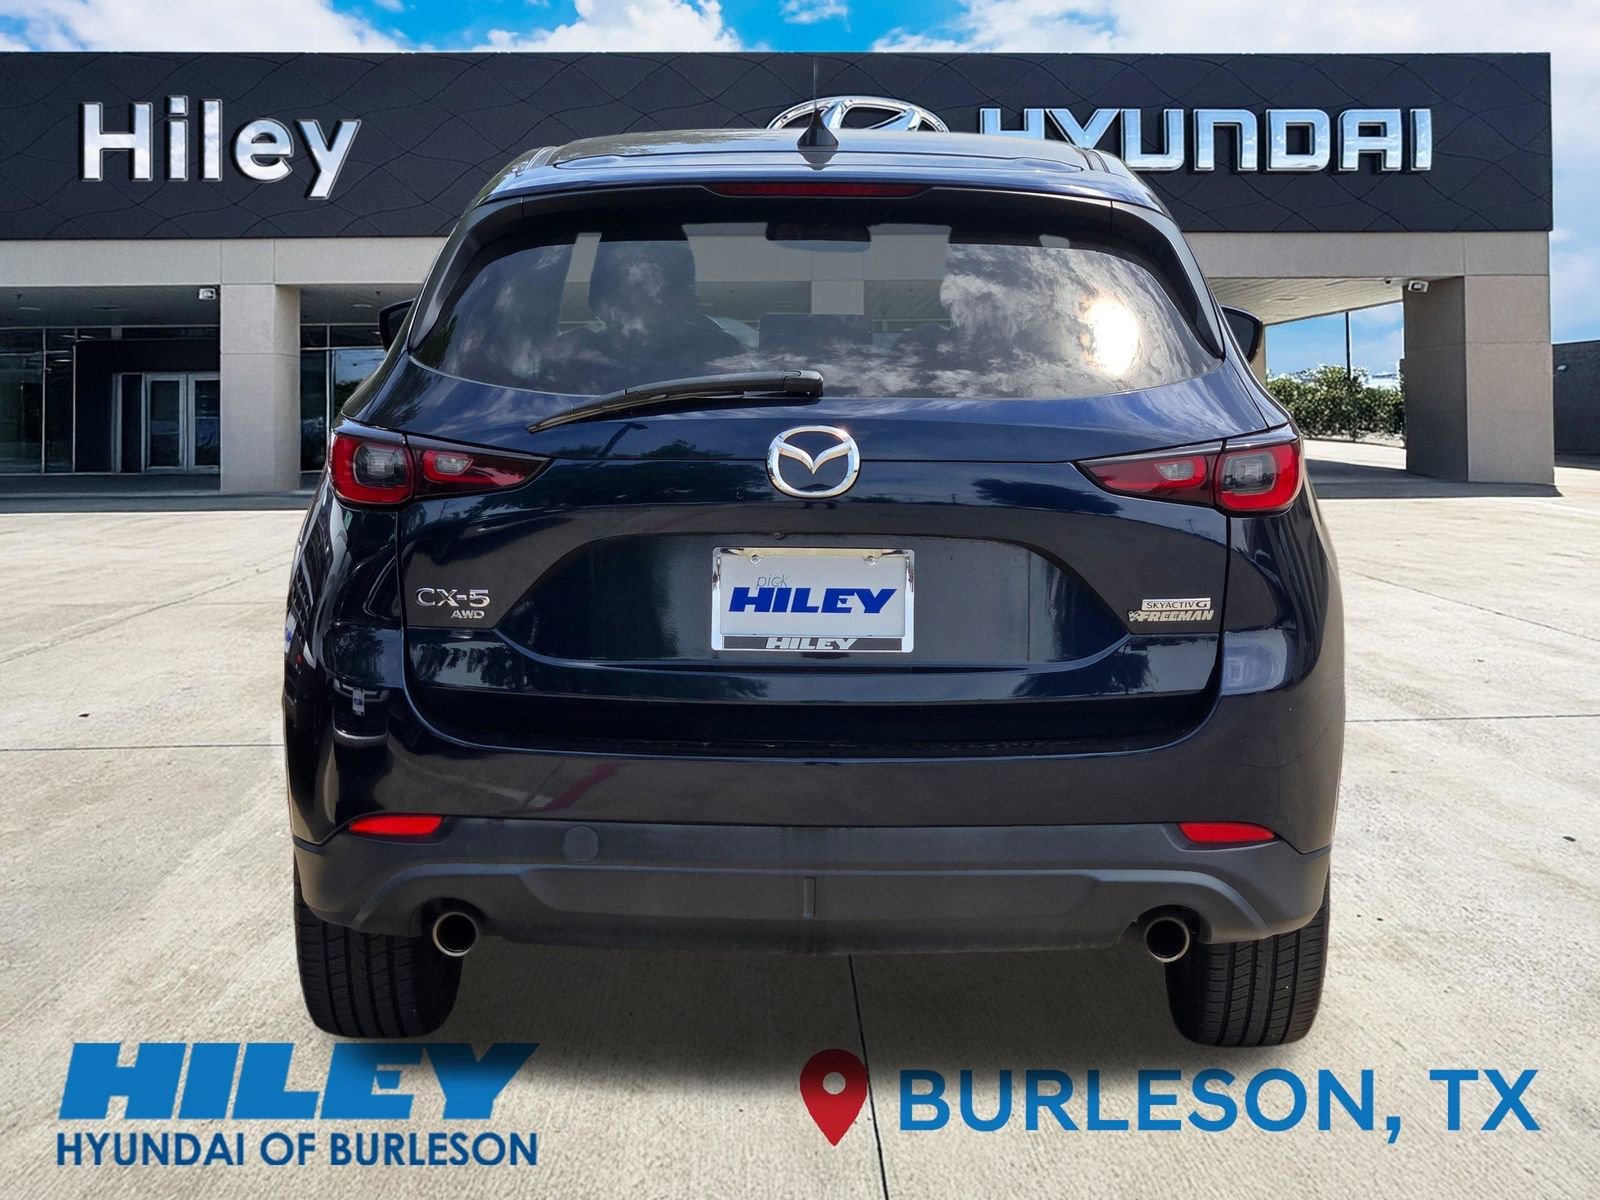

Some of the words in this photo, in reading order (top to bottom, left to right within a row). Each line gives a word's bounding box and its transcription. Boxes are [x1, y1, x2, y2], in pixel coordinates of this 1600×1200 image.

[80, 95, 361, 200] Hiley
[756, 574, 790, 588] pick
[416, 588, 490, 607] CX-5
[729, 586, 897, 613] HILEY
[450, 609, 485, 618] AWD
[1137, 610, 1214, 621] FREEMAN
[765, 637, 858, 650] HILEY
